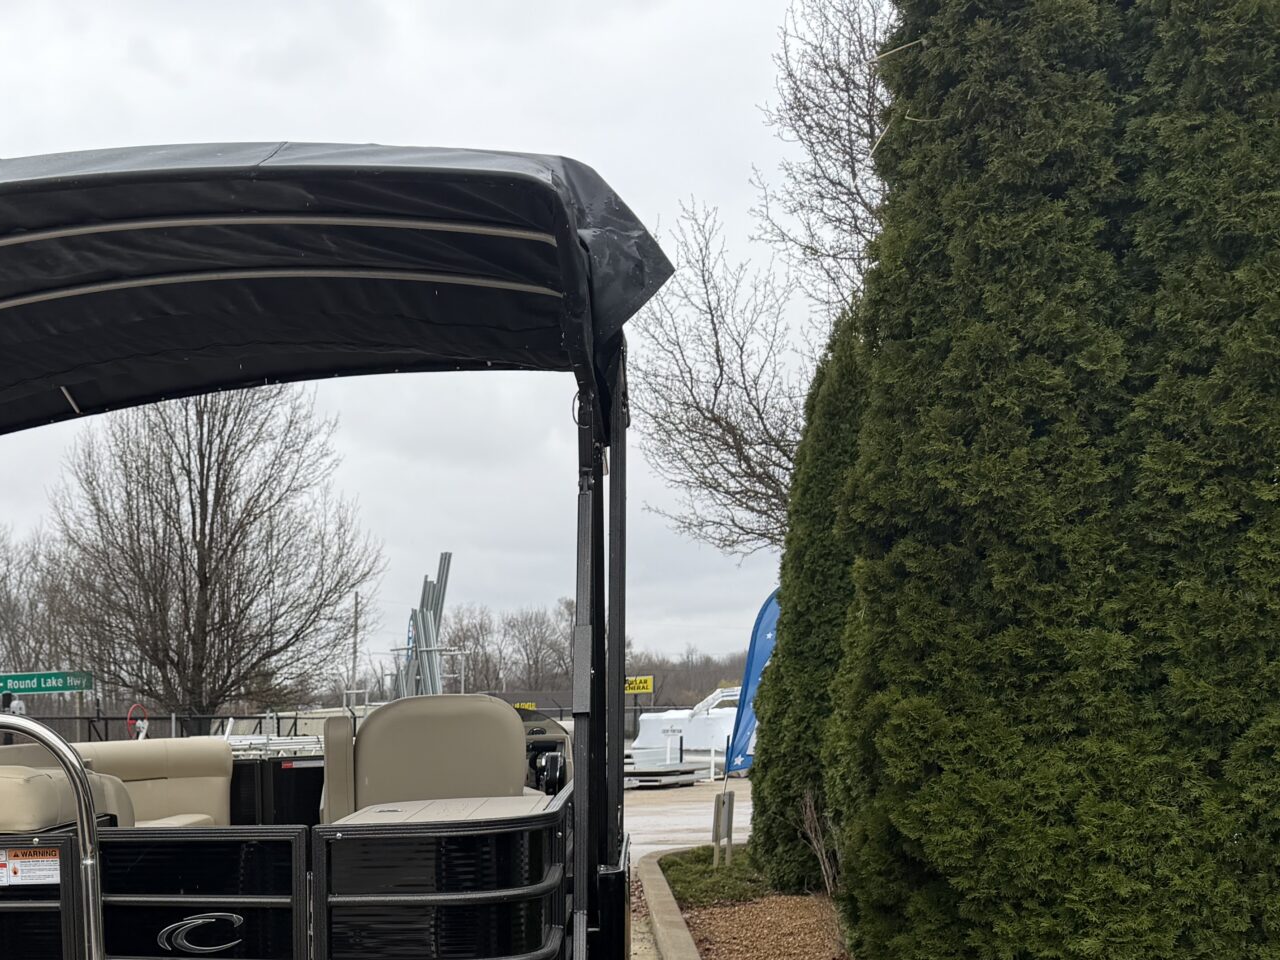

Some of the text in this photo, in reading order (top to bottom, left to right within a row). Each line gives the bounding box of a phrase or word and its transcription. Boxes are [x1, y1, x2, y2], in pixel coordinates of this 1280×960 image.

[7, 676, 87, 689] Round Lake Hwy
[21, 849, 57, 858] WARNING
